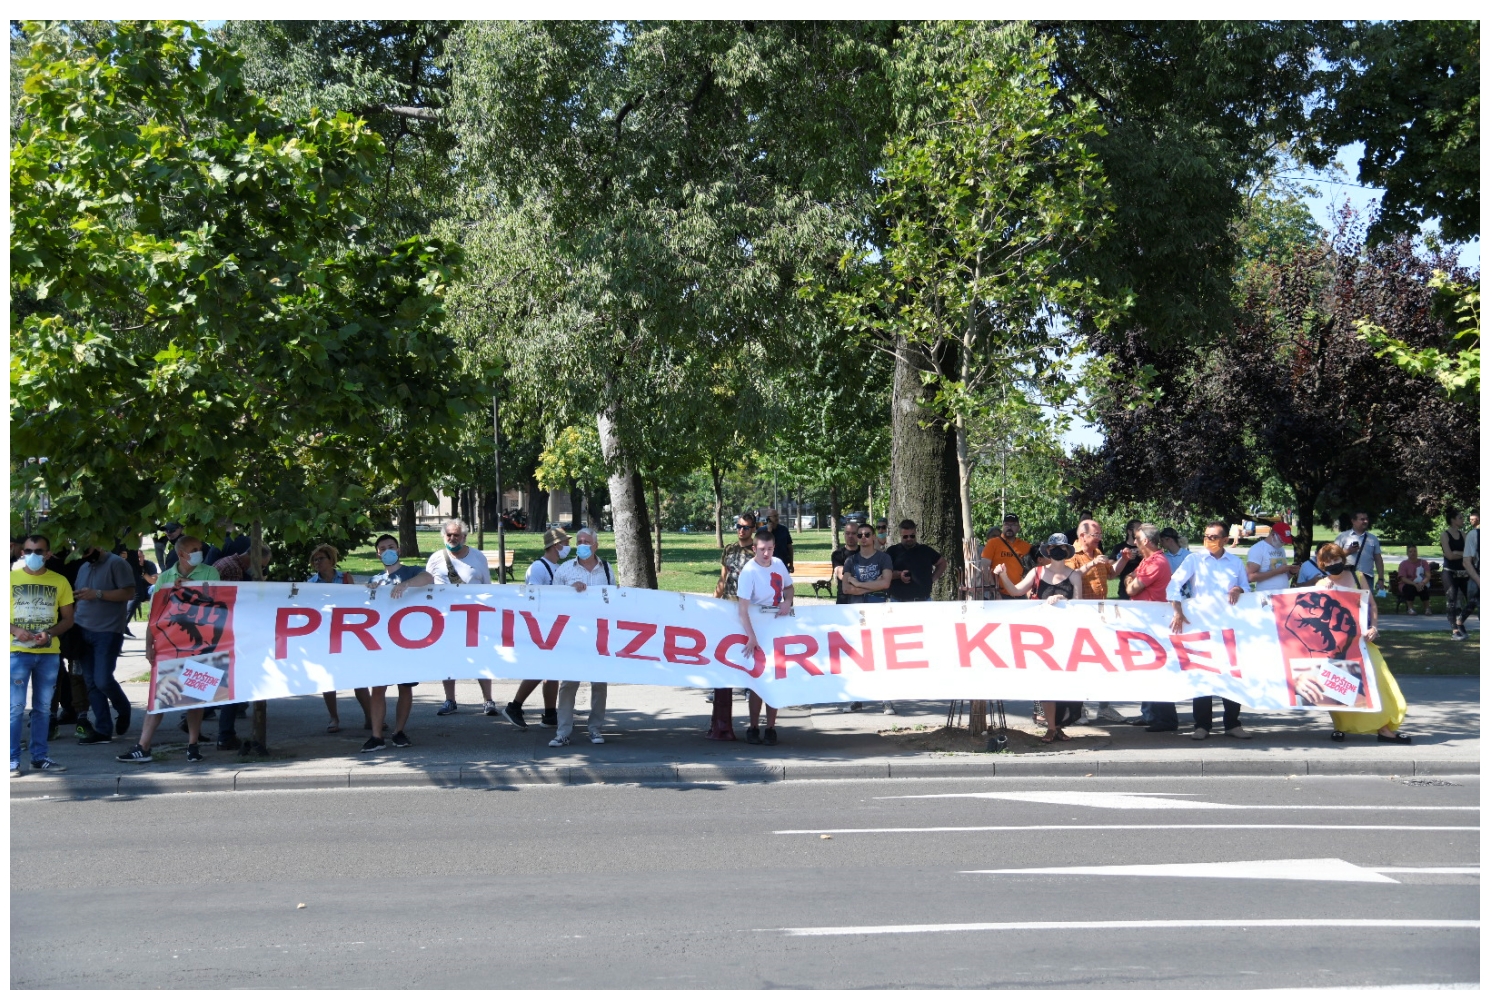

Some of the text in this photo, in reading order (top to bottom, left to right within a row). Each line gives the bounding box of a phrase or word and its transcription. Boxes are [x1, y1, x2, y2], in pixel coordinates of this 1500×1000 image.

[275, 604, 1242, 679] PROTIV IZBORNE KRAĐE!
[182, 668, 221, 687] ZA POŠTENE
[183, 678, 209, 692] IZBORE
[1321, 669, 1357, 692] ZA POŠTENE
[1324, 679, 1348, 695] IZBORE
